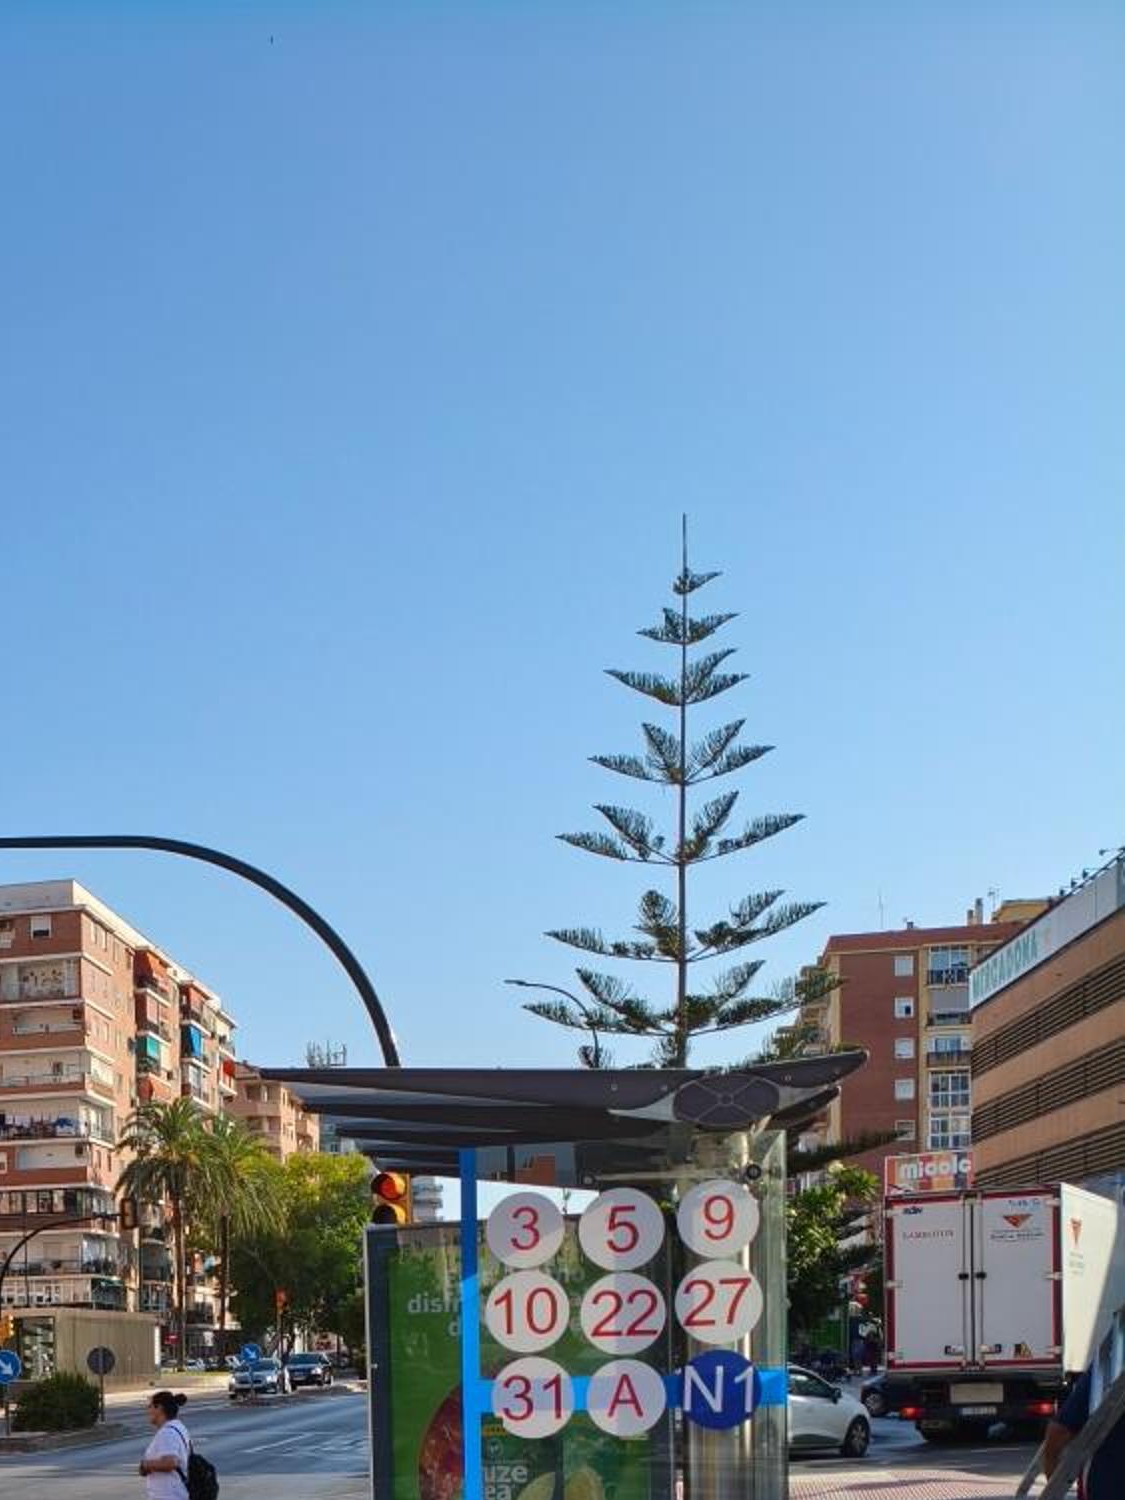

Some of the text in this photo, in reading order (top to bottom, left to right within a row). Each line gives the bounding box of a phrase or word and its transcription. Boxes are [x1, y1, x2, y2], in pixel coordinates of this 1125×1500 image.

[510, 1206, 540, 1251] 3
[606, 1205, 639, 1253] 5
[704, 1195, 735, 1240] 9
[494, 1287, 558, 1335] 10
[591, 1290, 658, 1337] 22
[683, 1277, 752, 1327] 27
[502, 1373, 563, 1421] 31
[608, 1373, 644, 1418] A
[683, 1365, 754, 1413] N1
[483, 1465, 528, 1484] uze
